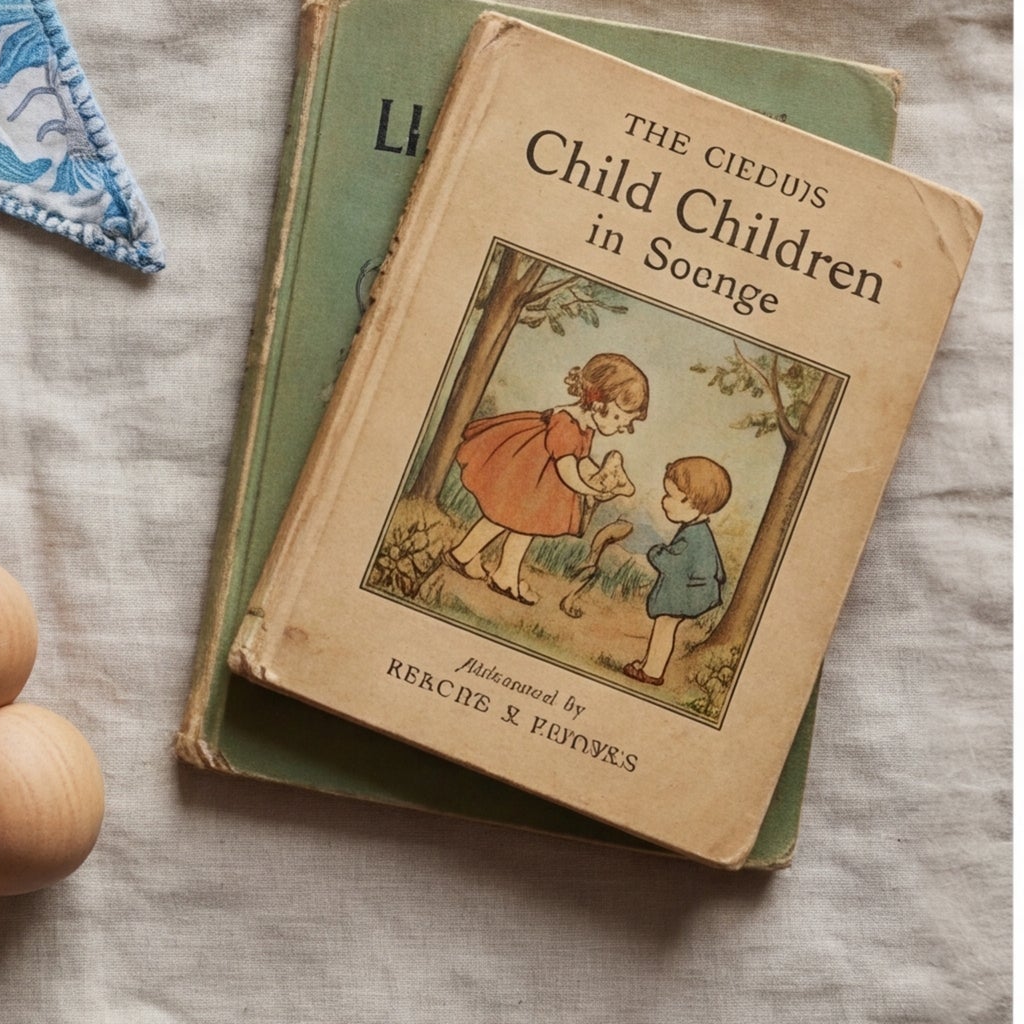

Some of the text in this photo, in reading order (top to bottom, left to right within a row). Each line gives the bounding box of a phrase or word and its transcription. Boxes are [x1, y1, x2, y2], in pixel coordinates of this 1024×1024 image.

[624, 112, 691, 156] THE
[526, 129, 883, 305] Child Children
[585, 214, 624, 256] in
